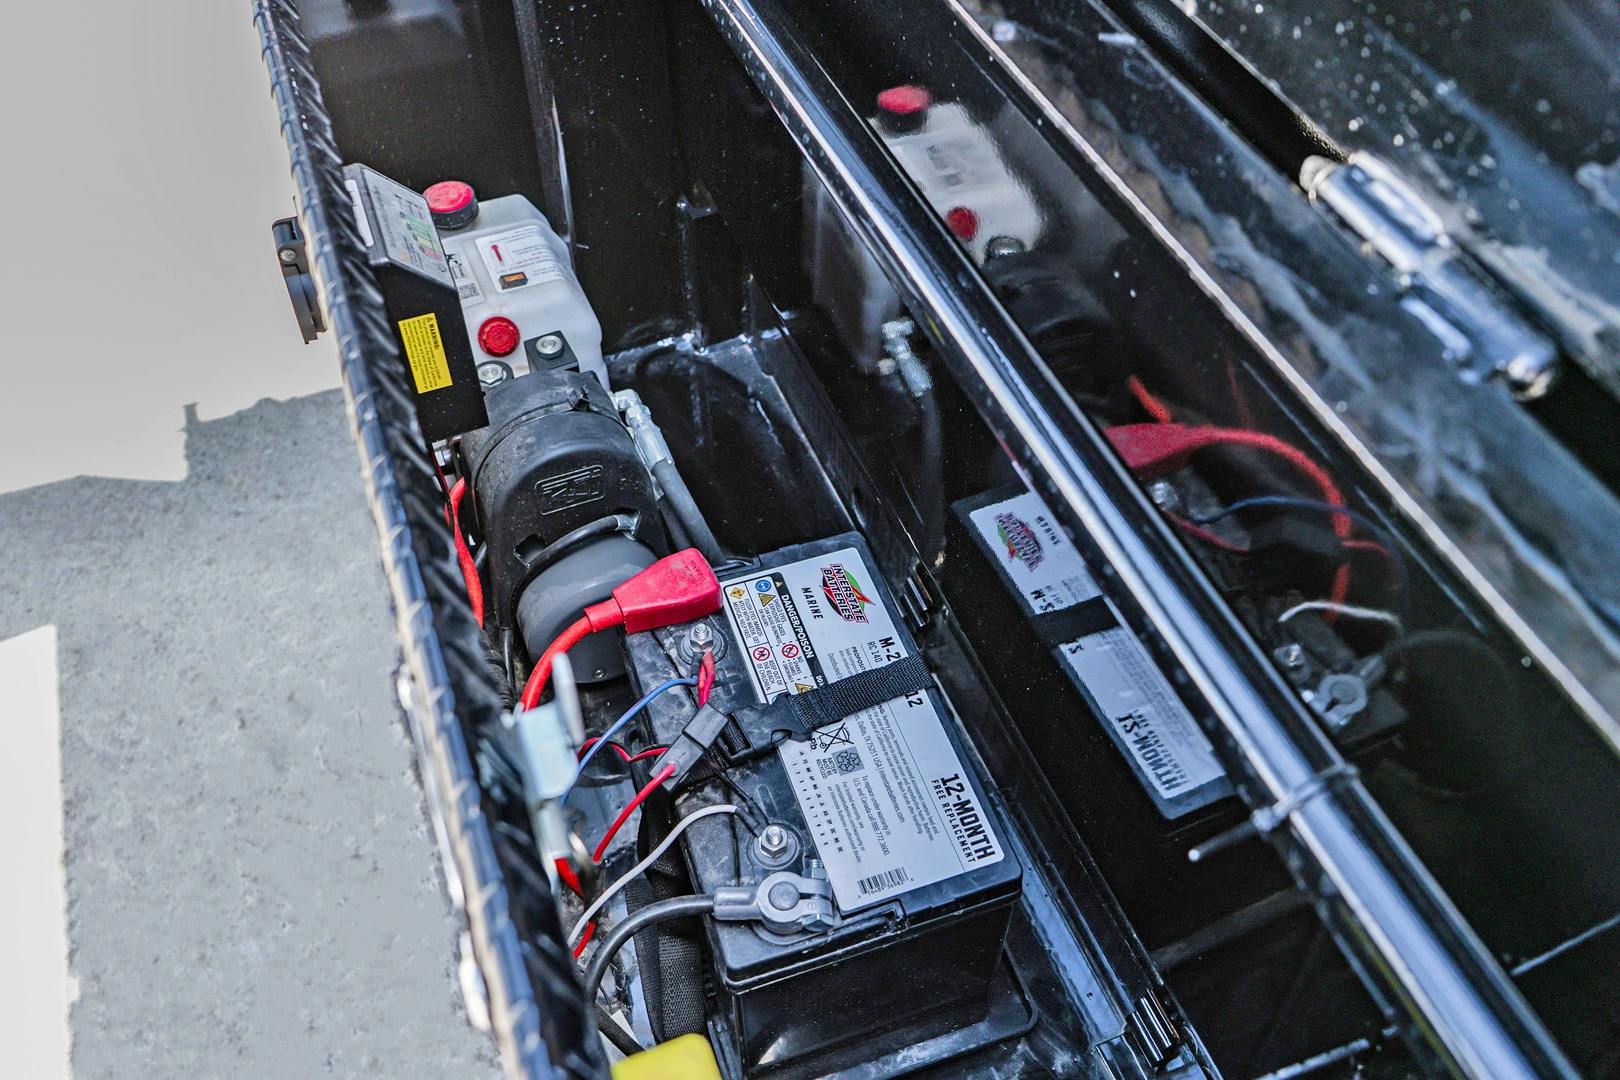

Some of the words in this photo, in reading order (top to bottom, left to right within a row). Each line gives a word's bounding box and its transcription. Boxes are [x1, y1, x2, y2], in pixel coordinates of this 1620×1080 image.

[801, 587, 824, 619] MARINE
[823, 569, 853, 621] BATTERIES
[832, 565, 865, 621] INTERSTATE
[768, 603, 781, 624] EXPLOSIVE
[777, 623, 786, 636] GASES
[781, 594, 814, 658] DANGER/POISON
[851, 646, 866, 672] PROPOSIT
[867, 641, 877, 650] RC
[871, 650, 883, 663] 140
[769, 660, 777, 670] KEEP
[773, 671, 781, 679] OUT
[931, 779, 946, 800] FREE
[942, 802, 976, 862] REPLACEMENT
[940, 773, 996, 860] 12-MONTH
